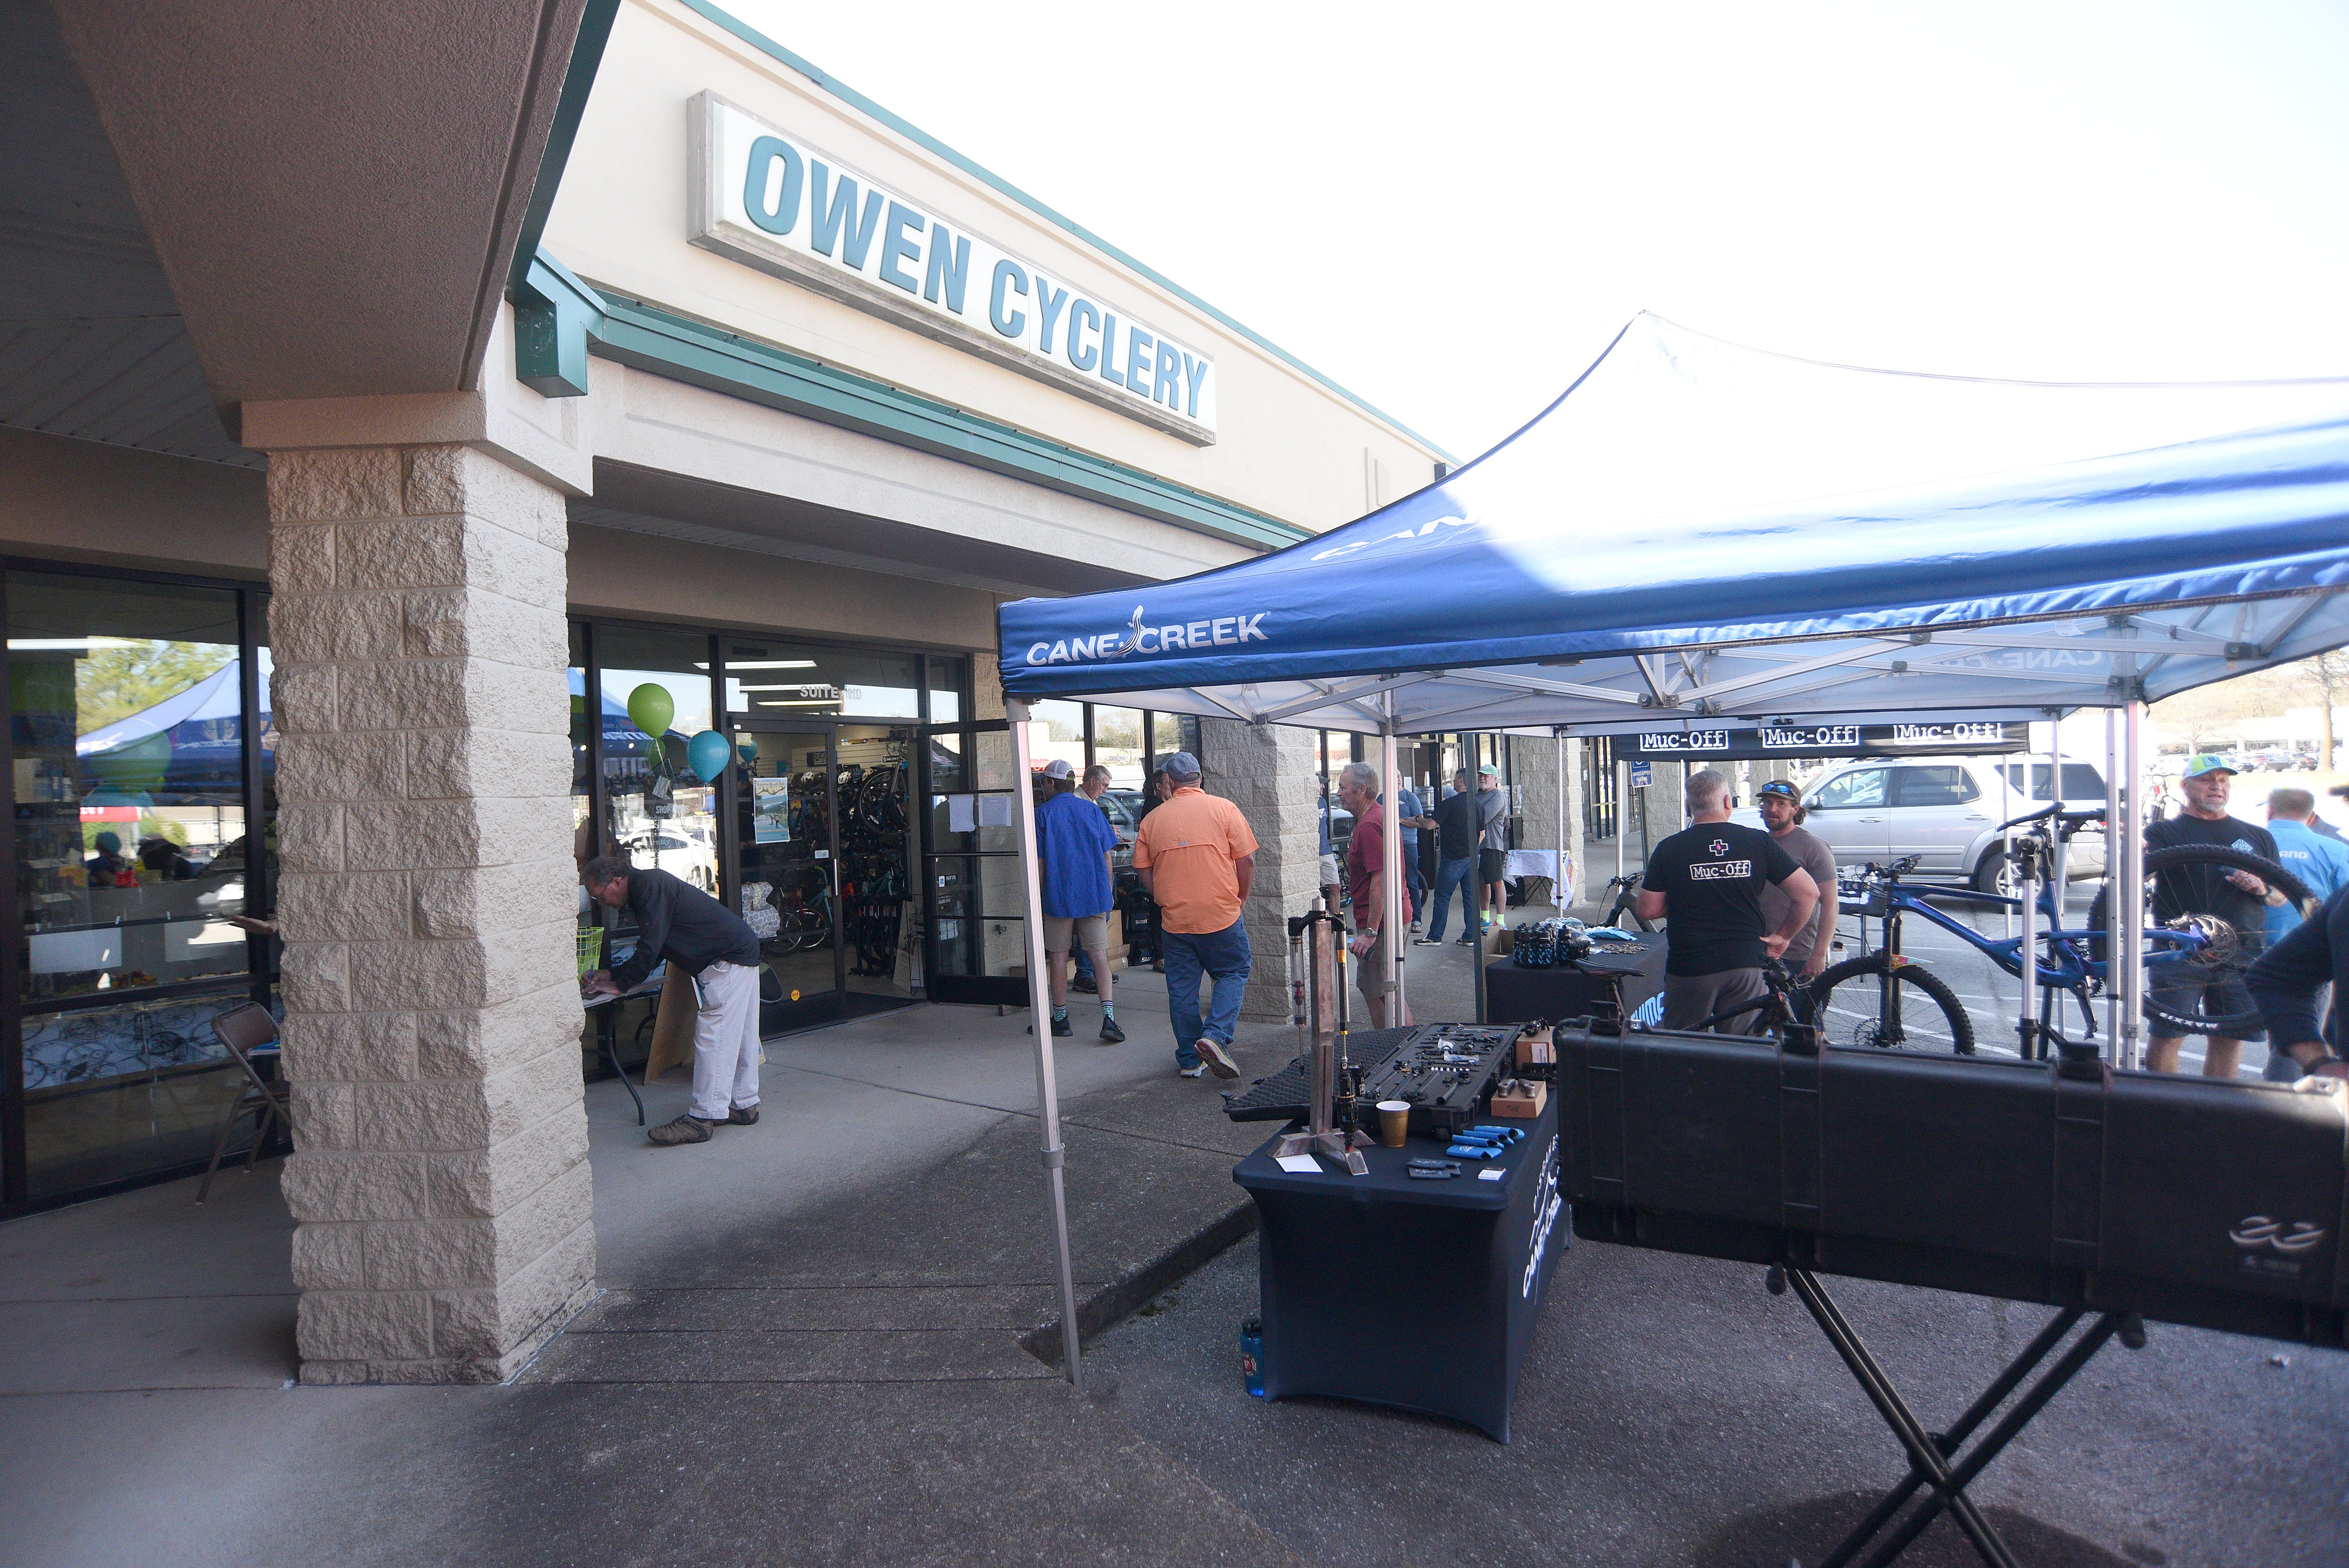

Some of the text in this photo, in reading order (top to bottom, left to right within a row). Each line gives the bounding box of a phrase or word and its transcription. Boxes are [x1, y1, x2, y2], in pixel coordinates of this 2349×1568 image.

[743, 135, 1208, 419] OWEN CYCLERY
[1026, 612, 1269, 666] CANE CREEK
[800, 686, 862, 700] SUITE 110
[1643, 731, 1723, 748] Muc-Off
[1766, 726, 1855, 745] Muc-Off
[1693, 862, 1748, 878] Muc-Off
[2158, 1012, 2219, 1028] MAXXIS
[1523, 1192, 1562, 1298] CANE CREE
